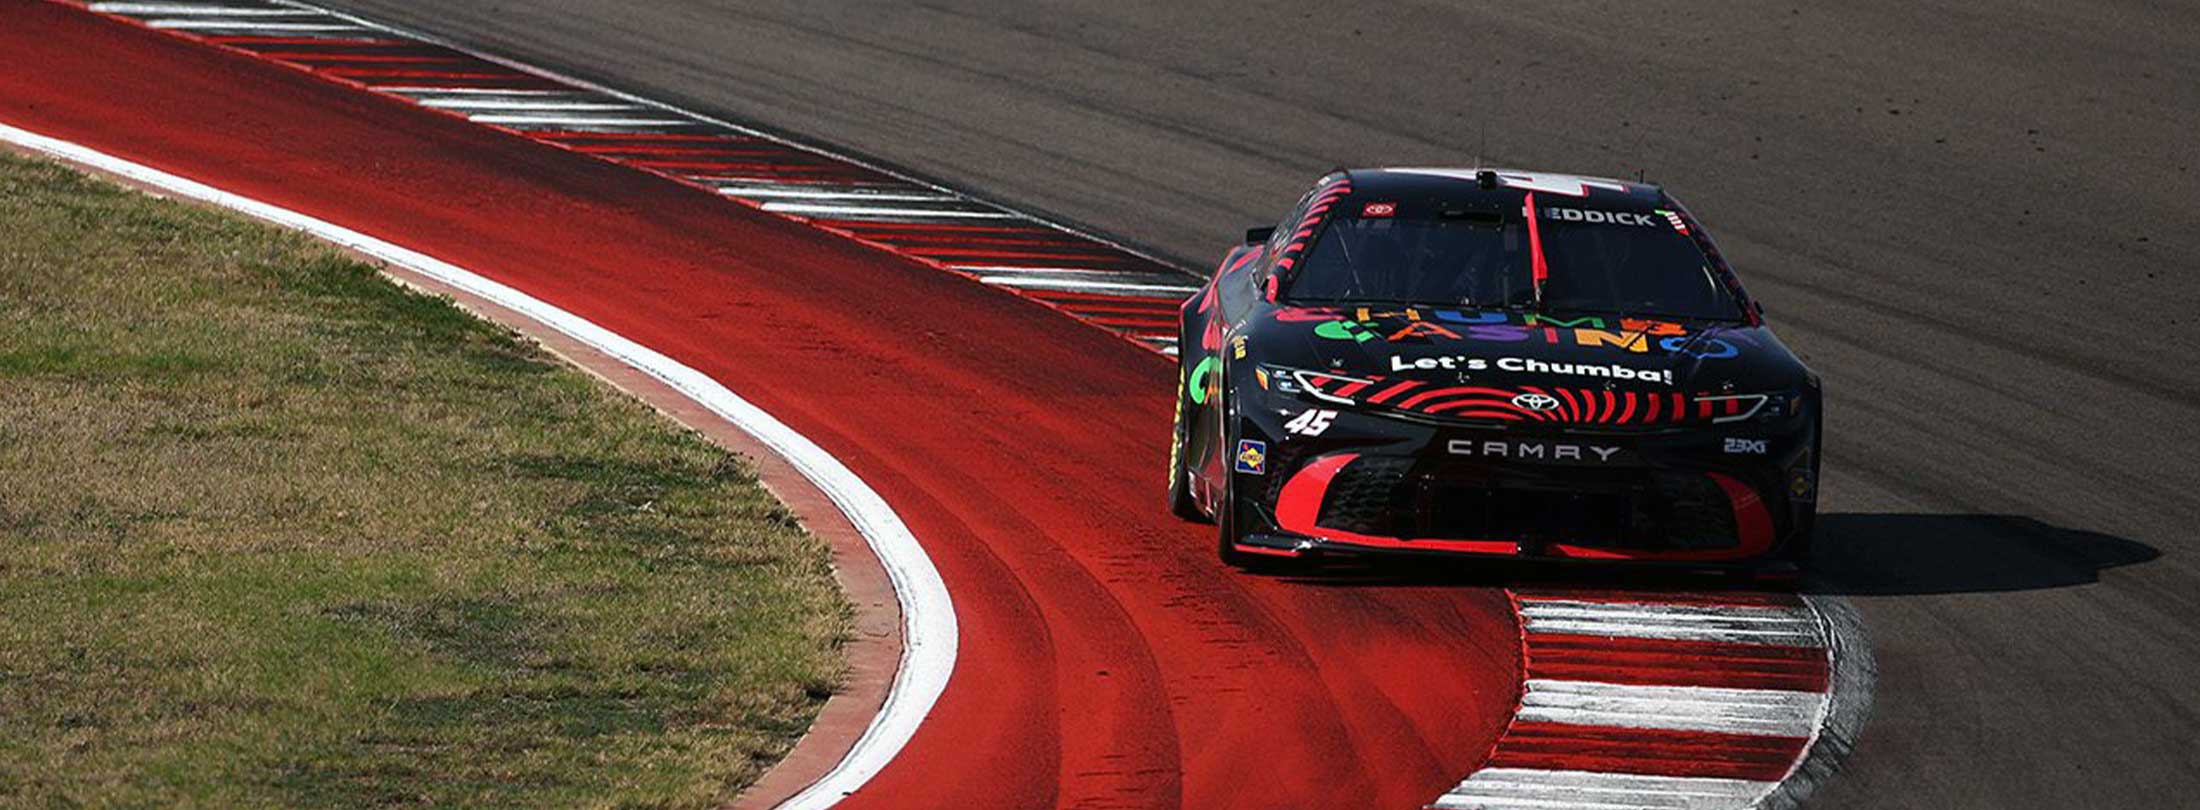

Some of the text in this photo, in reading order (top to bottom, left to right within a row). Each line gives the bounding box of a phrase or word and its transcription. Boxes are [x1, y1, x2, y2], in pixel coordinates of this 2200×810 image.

[1522, 206, 1656, 227] EDDICK
[1391, 355, 1673, 386] Let's Chumba!
[1284, 408, 1338, 436] 45
[1448, 439, 1621, 462] CAMRY
